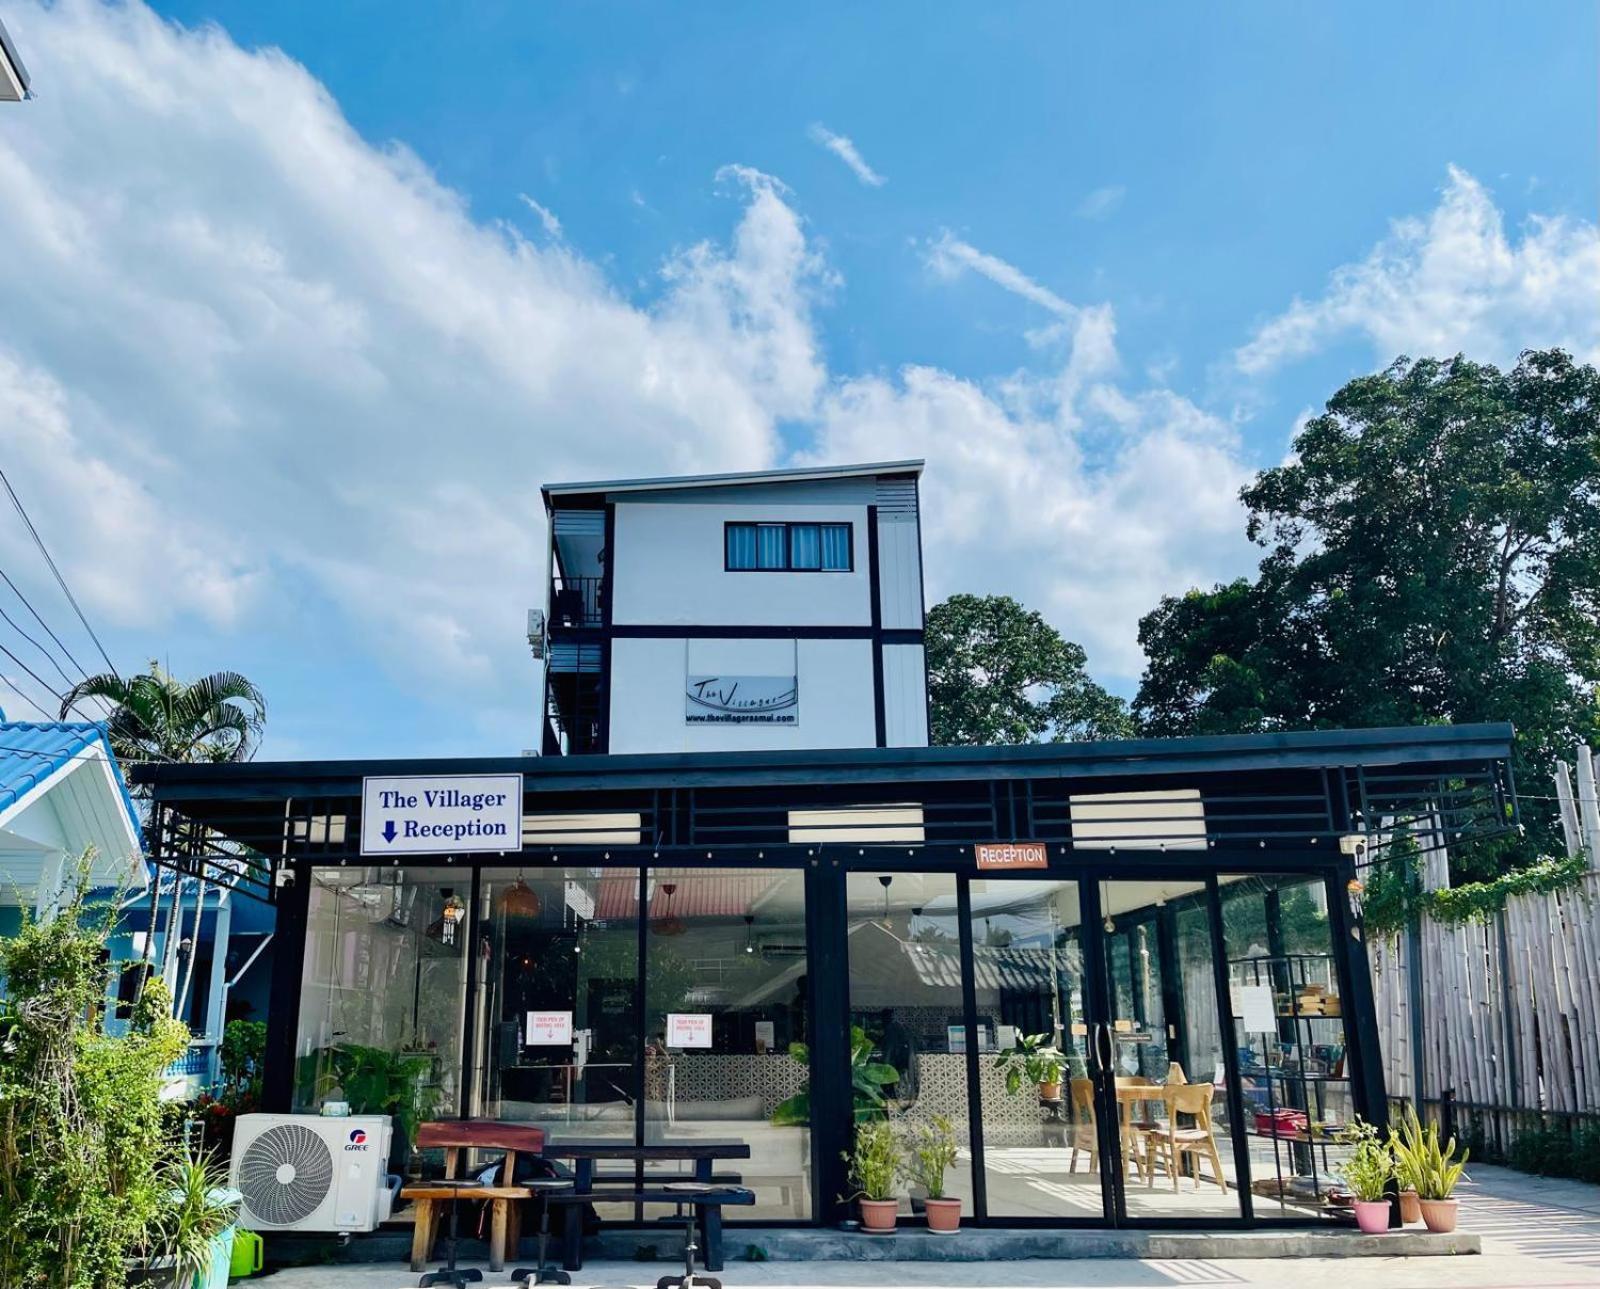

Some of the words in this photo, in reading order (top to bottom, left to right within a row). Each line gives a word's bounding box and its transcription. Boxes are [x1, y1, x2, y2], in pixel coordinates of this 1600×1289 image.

[379, 791, 418, 809] The
[424, 790, 507, 811] Villager
[404, 819, 507, 840] Reception
[979, 847, 1043, 863] RECEPTION
